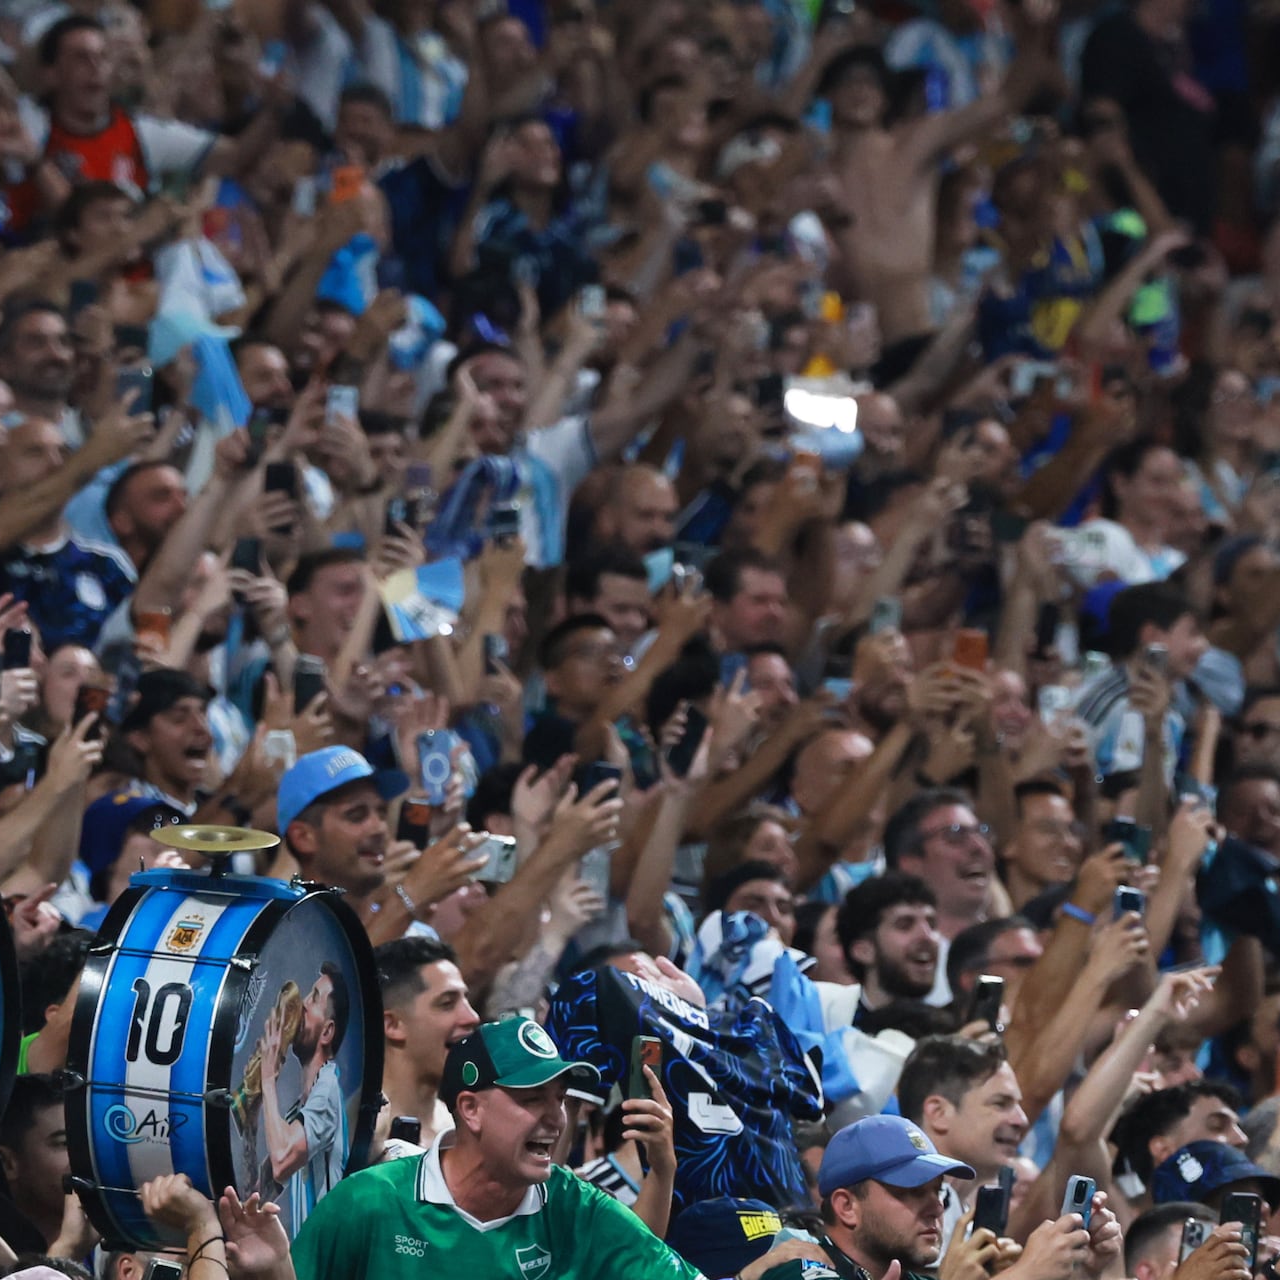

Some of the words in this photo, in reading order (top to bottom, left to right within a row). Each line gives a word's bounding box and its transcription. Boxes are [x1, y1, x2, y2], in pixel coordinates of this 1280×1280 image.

[125, 977, 195, 1065] 10
[394, 1234, 429, 1250] SPORT
[394, 1245, 425, 1257] 2000
